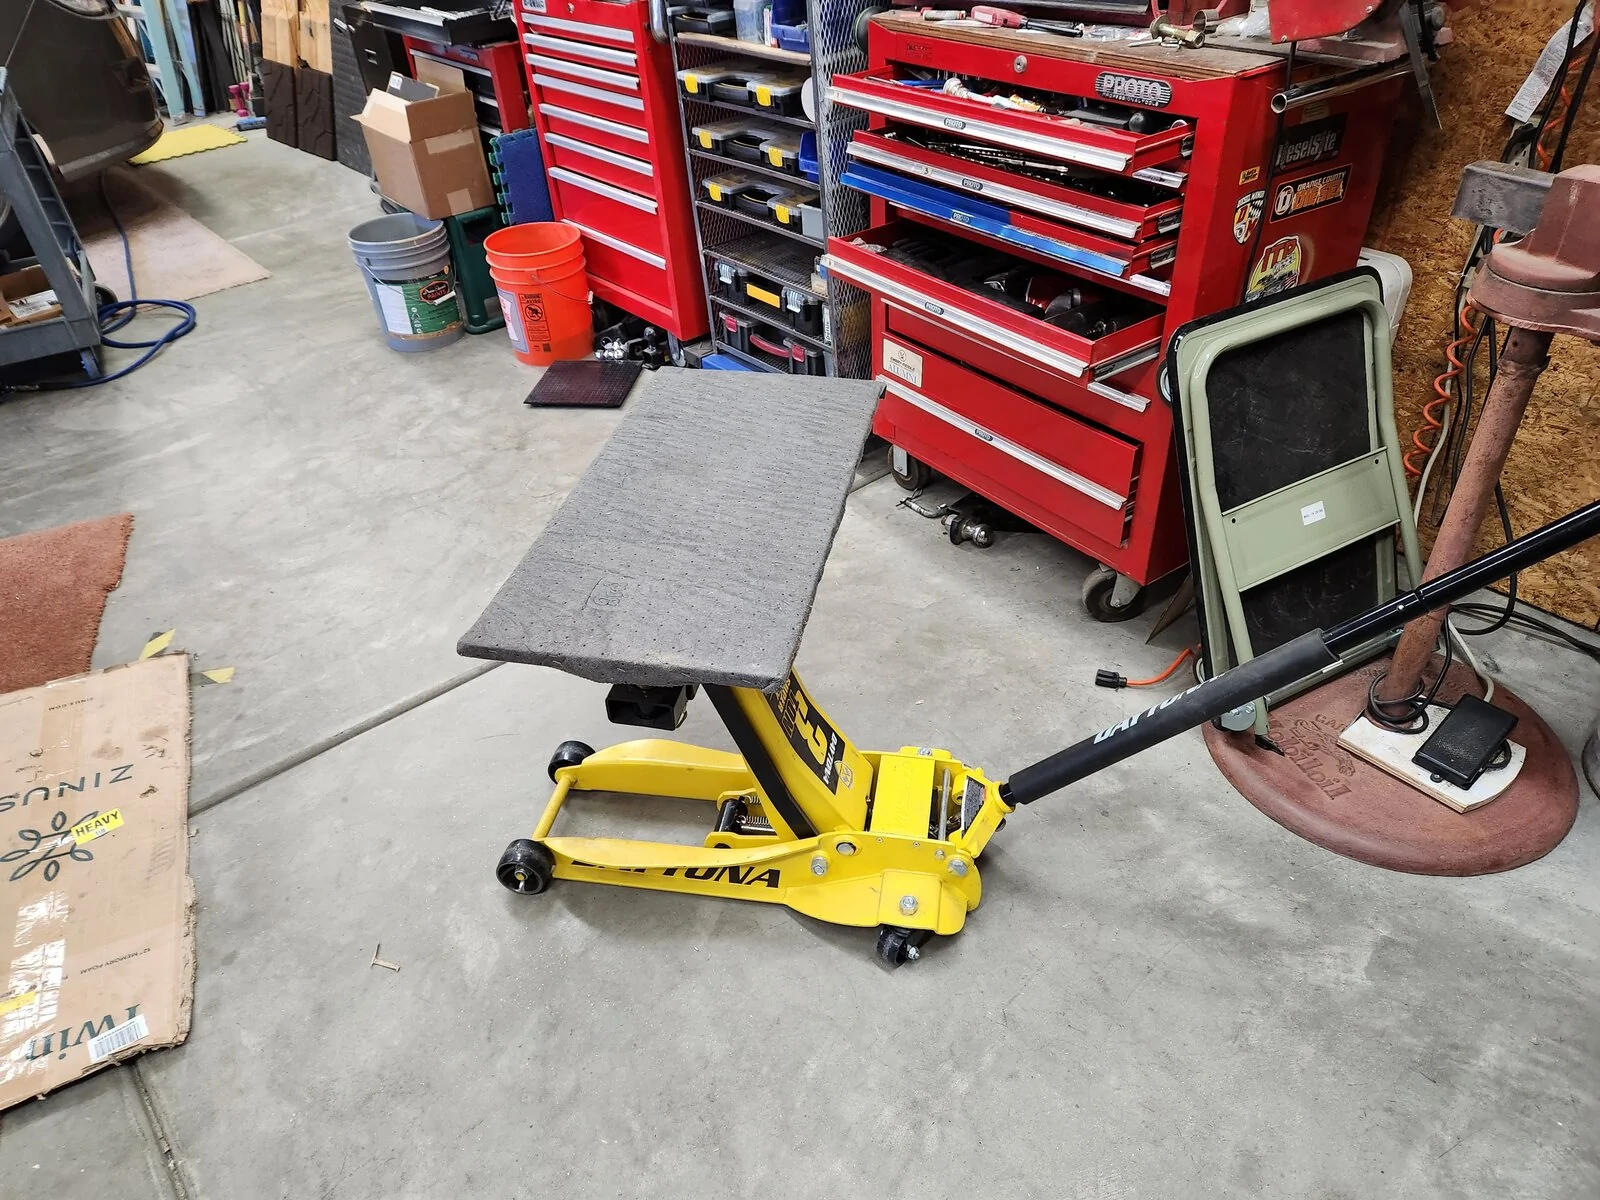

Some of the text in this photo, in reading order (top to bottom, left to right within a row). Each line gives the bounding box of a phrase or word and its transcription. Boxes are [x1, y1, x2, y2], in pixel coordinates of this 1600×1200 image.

[1102, 75, 1161, 99] PROTO
[945, 117, 963, 128] PROTO
[963, 178, 981, 189] PROTO
[953, 212, 970, 223] PROTO
[926, 302, 941, 314] PROTO
[976, 429, 991, 440] PROTO
[782, 689, 798, 738] TON
[795, 690, 828, 765] 3
[75, 811, 120, 837] HEAVY
[105, 951, 139, 966] MEMORY
[80, 963, 103, 975] FOAM
